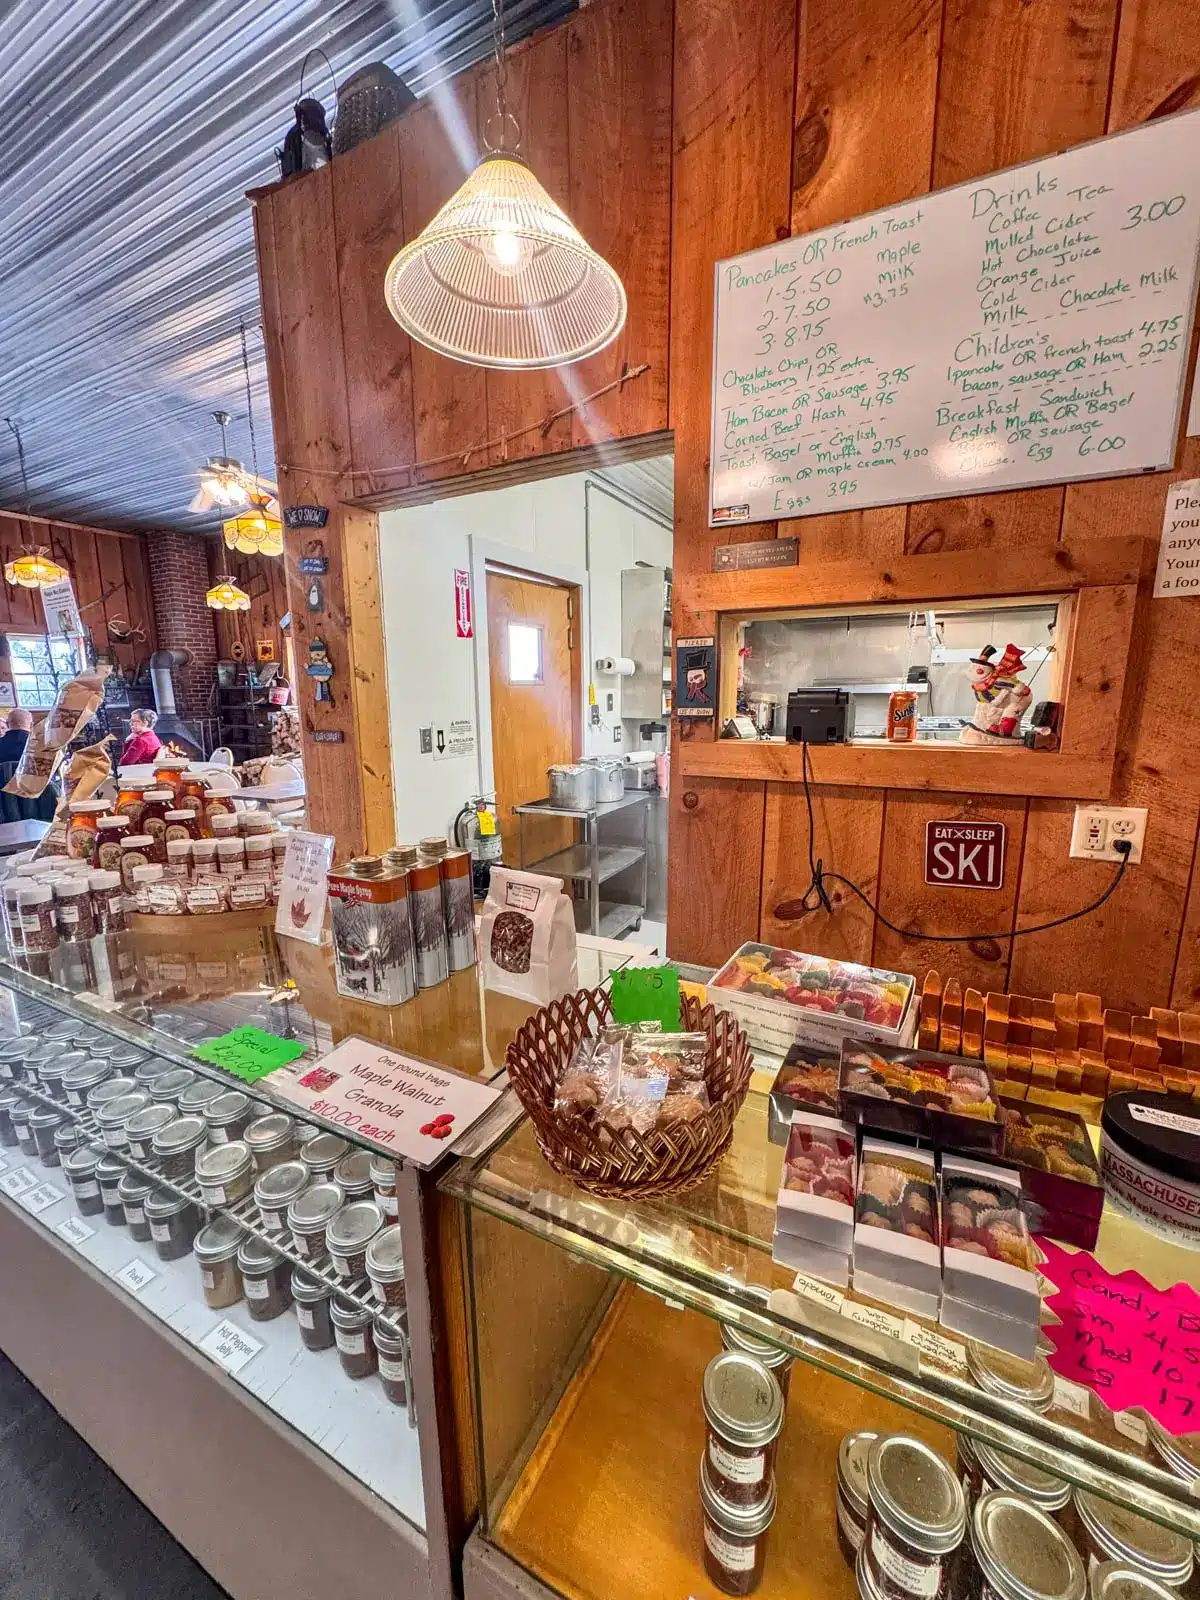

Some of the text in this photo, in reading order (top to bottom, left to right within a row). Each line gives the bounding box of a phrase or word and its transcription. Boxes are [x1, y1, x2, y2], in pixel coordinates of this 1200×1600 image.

[968, 171, 1059, 219] Drinks
[988, 185, 1115, 234] Coffee Tea
[985, 195, 1186, 256] Mulled Cider 3.00
[726, 210, 924, 290] Pancakes OR French Toast
[877, 241, 921, 264] Maple
[981, 232, 1098, 276] Hot Chocolate
[878, 262, 915, 285] Milk
[976, 247, 1102, 293] Orange Juice
[980, 274, 1076, 311] Cold Cider
[983, 305, 1028, 326] Milk
[1140, 265, 1179, 287] Milk
[954, 332, 1050, 363] Children's
[1012, 351, 1037, 367] OR
[1044, 341, 1091, 360] french
[1094, 329, 1135, 346] toast
[1139, 315, 1183, 338] 4.75
[722, 343, 837, 389] Chocolate Chips OR
[741, 376, 797, 397] Blueberry
[840, 356, 875, 372] extra
[1008, 367, 1064, 386] sausage
[1066, 358, 1087, 373] OR
[1092, 350, 1127, 366] Ham
[1138, 334, 1182, 358] 2.25
[725, 365, 916, 432] Ham Bacon OR Sausage 3.95
[936, 380, 1114, 427] Breakfast Sandwich
[724, 390, 899, 450] Corned Beef Hash 4.95
[949, 423, 998, 444] English
[1053, 405, 1079, 421] OR
[1087, 392, 1135, 414] Bagel
[1007, 428, 1031, 444] OR
[1040, 419, 1104, 438] sausage
[762, 442, 801, 462] Bagel
[829, 427, 877, 447] English
[817, 445, 862, 463] Muffin
[1026, 443, 1053, 461] Egg
[1078, 436, 1126, 456] 6.00
[796, 467, 813, 481] OR
[817, 463, 852, 478] maple
[857, 458, 896, 470] cream
[457, 575, 468, 586] FIRE
[1162, 580, 1170, 589] a
[935, 828, 996, 840] EAT SLEEP
[931, 841, 995, 883] SKI
[232, 1032, 279, 1055] Special
[350, 1063, 446, 1107] Maple Walnut
[377, 1054, 451, 1088] One pound bags
[344, 1088, 406, 1119] Granola
[309, 1098, 397, 1144] $10.00 each
[1127, 1191, 1160, 1219] Maple
[126, 1268, 146, 1285] Peach
[798, 1278, 839, 1306] Tomato
[1070, 1268, 1160, 1321] Candy
[851, 1312, 900, 1339] Blackberry
[864, 1308, 892, 1326] Jam
[216, 1342, 234, 1359] Jelly
[218, 1325, 254, 1356] Hot Pepper
[1076, 1330, 1131, 1363] Med
